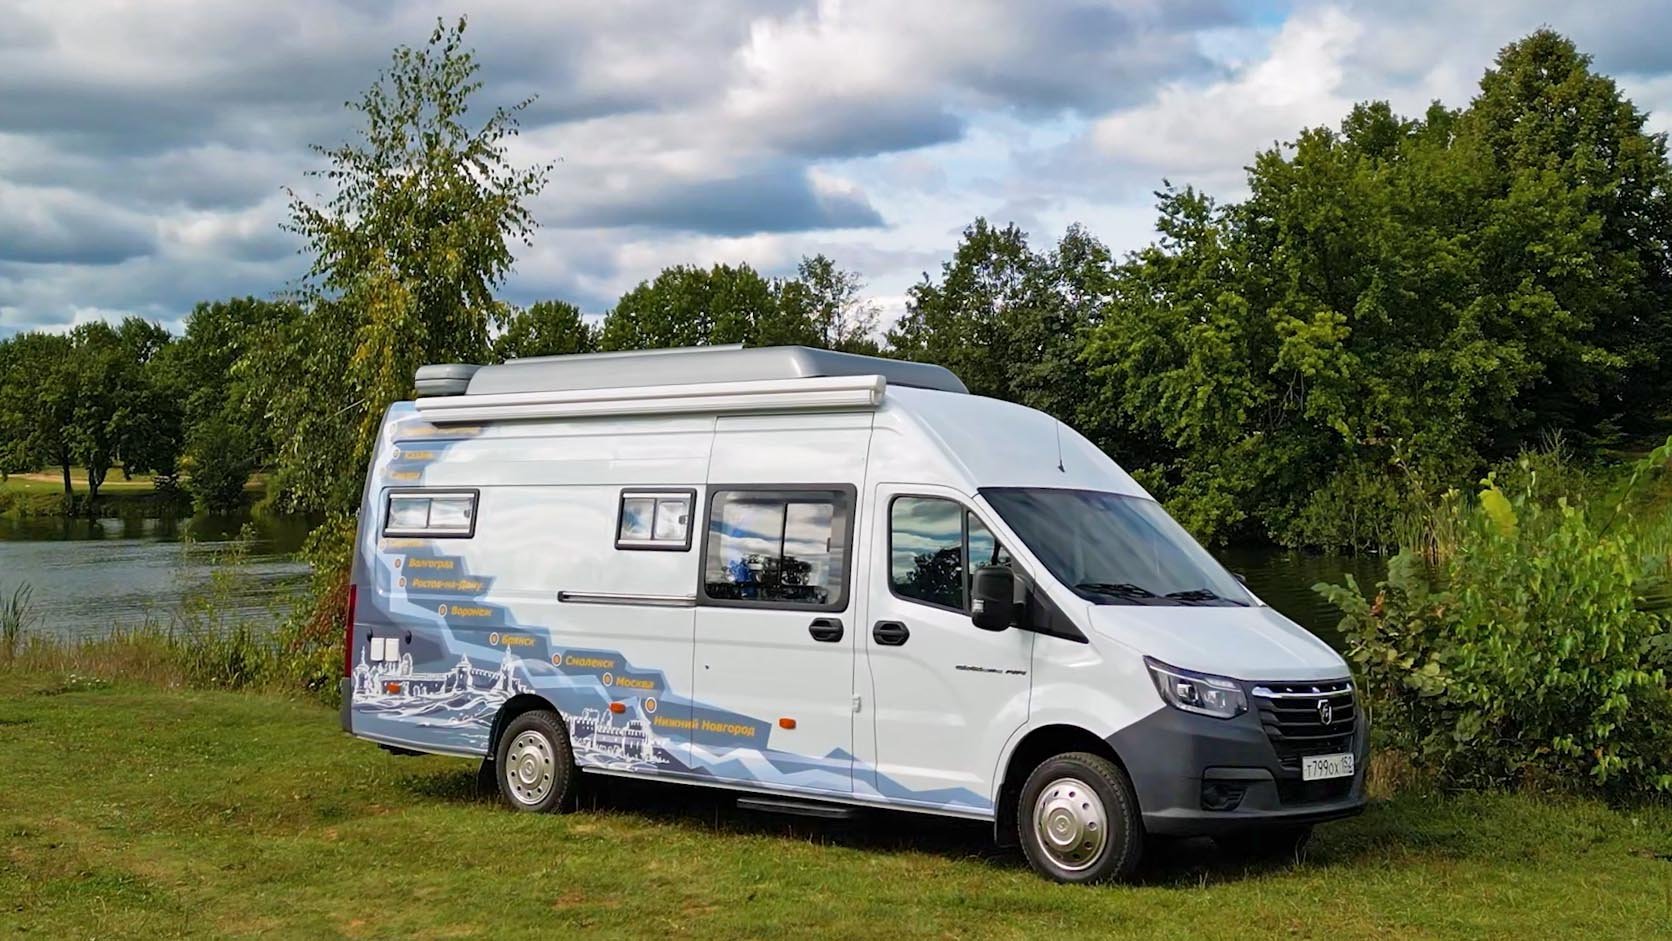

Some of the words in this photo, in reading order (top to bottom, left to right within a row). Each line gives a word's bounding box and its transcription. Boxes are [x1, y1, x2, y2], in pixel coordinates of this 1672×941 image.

[615, 676, 655, 690] Москва
[653, 716, 699, 730] Нижний
[701, 720, 756, 737] Новгород
